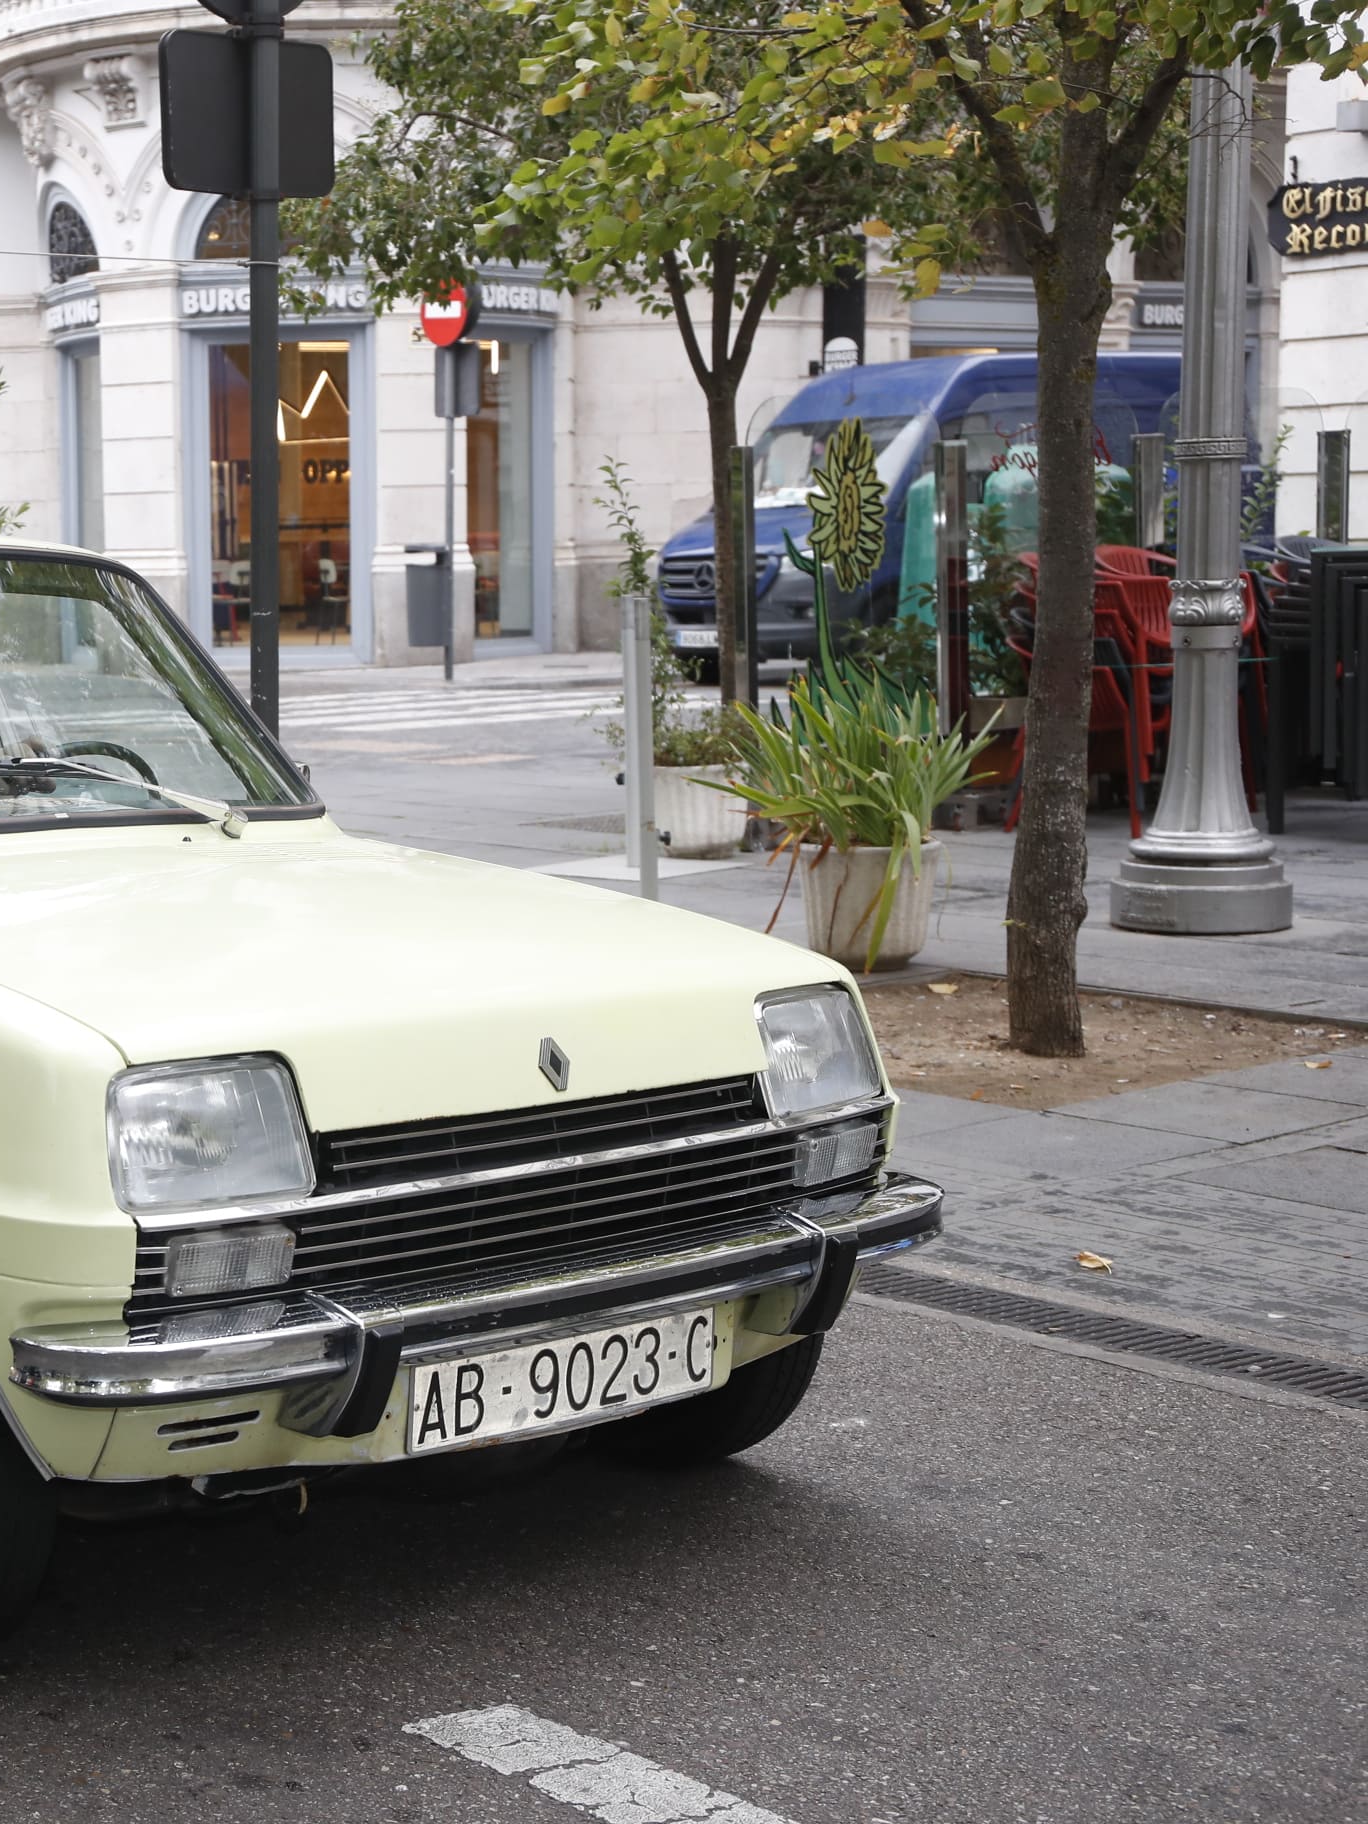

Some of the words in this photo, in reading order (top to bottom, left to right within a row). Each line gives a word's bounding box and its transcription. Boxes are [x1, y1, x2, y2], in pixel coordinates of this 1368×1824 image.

[1282, 186, 1313, 219] El
[1315, 183, 1368, 221] Fis
[182, 287, 262, 314] BURG
[482, 284, 538, 311] URGER
[417, 1315, 708, 1445] AB-9023-C
